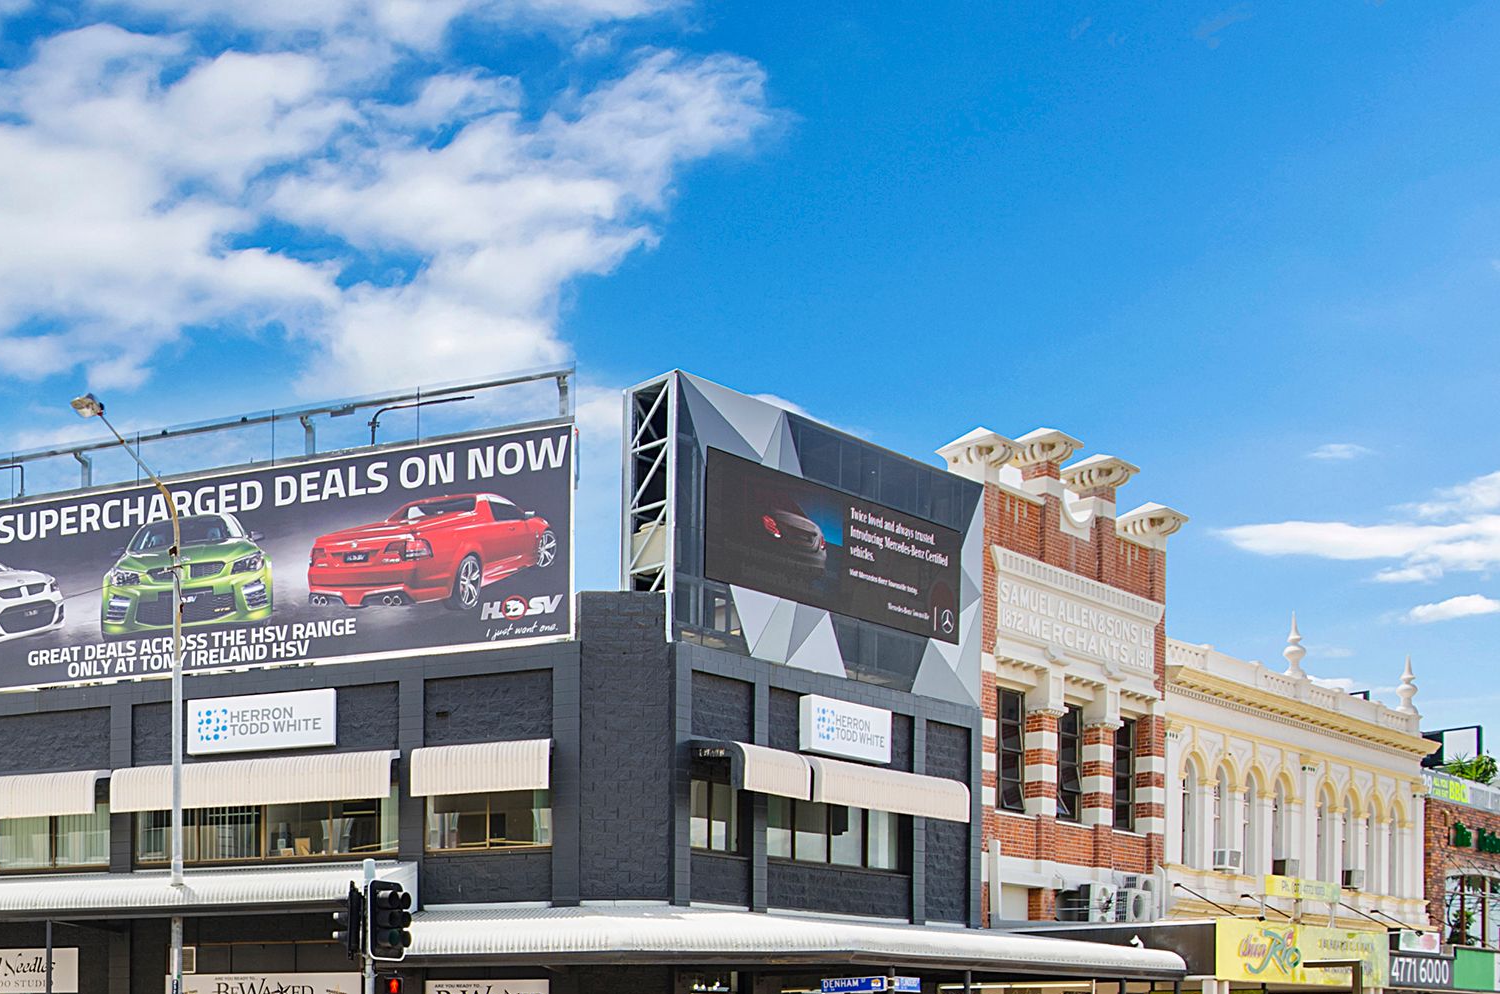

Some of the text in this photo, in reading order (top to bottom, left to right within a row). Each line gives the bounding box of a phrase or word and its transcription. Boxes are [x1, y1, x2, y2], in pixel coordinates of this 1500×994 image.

[274, 461, 389, 507] DEALS
[400, 451, 455, 490] ON
[467, 434, 569, 481] NOW
[850, 507, 936, 545] Twice loved and always trusted.
[850, 525, 949, 567] Introducing Mercedes-Benz Certified
[1000, 580, 1056, 618] SAMUEL
[1106, 616, 1139, 644] SONS
[27, 618, 357, 667] GREAT DEALS ACROSS THE HSV RANGE
[491, 626, 511, 640] just
[513, 622, 537, 635] want
[539, 624, 558, 633] one.
[67, 639, 310, 678] ONLY AT TONY IRELAND HSV
[230, 706, 294, 724] HERRON
[230, 717, 322, 737] TODD WHITE
[835, 714, 871, 733] HERRON
[835, 727, 885, 749] TODD WHITE
[1391, 957, 1417, 983] 4771
[1420, 958, 1450, 984] 6000
[14, 979, 54, 988] STUDI
[823, 978, 859, 989] DENHAM
